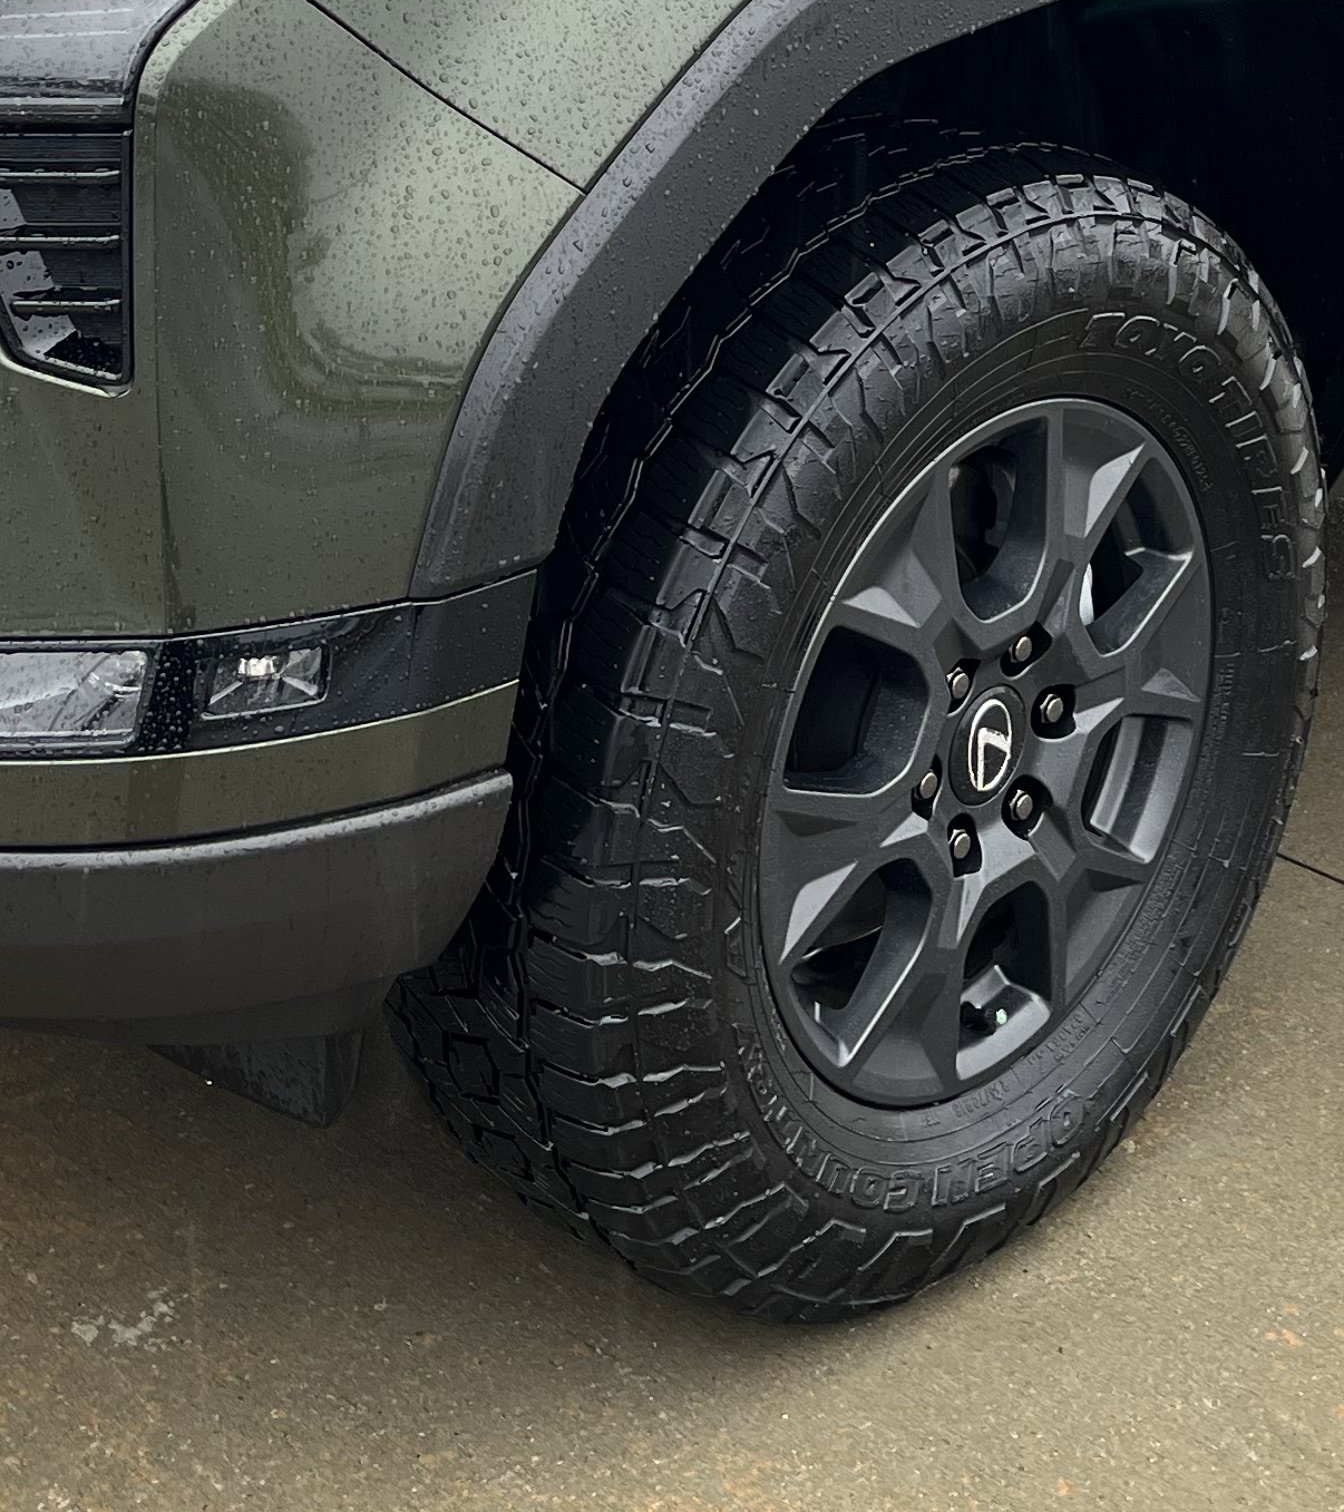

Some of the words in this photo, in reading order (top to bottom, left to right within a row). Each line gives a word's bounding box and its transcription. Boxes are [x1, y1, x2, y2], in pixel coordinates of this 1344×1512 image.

[1080, 311, 1222, 385] TOYO
[1208, 375, 1296, 580] TIRES
[931, 1089, 1088, 1208] OPEN
